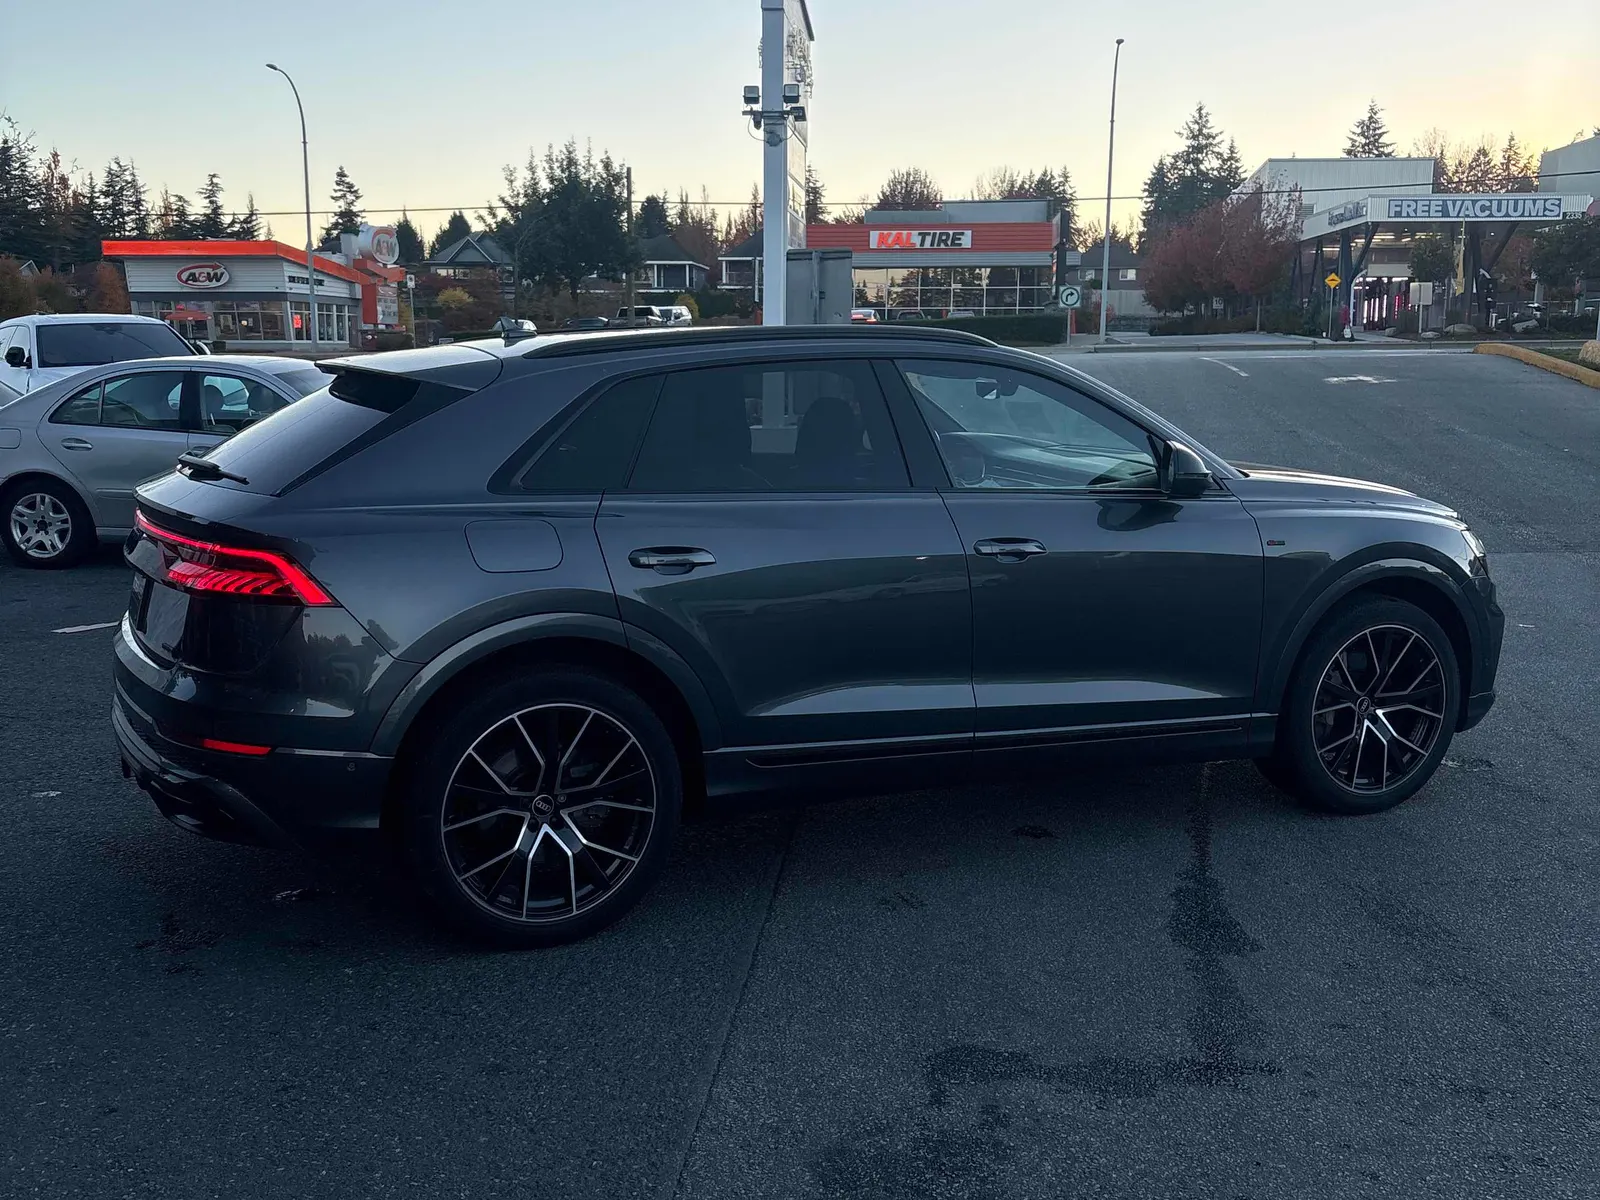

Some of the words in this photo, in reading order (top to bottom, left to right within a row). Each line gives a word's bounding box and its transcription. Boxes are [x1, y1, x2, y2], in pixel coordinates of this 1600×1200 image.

[1389, 200, 1443, 217] FREE
[1446, 199, 1560, 217] VACUUMS
[375, 238, 398, 258] A&W
[877, 232, 916, 248] KAL
[918, 232, 965, 247] TIRE
[185, 272, 225, 282] A&W
